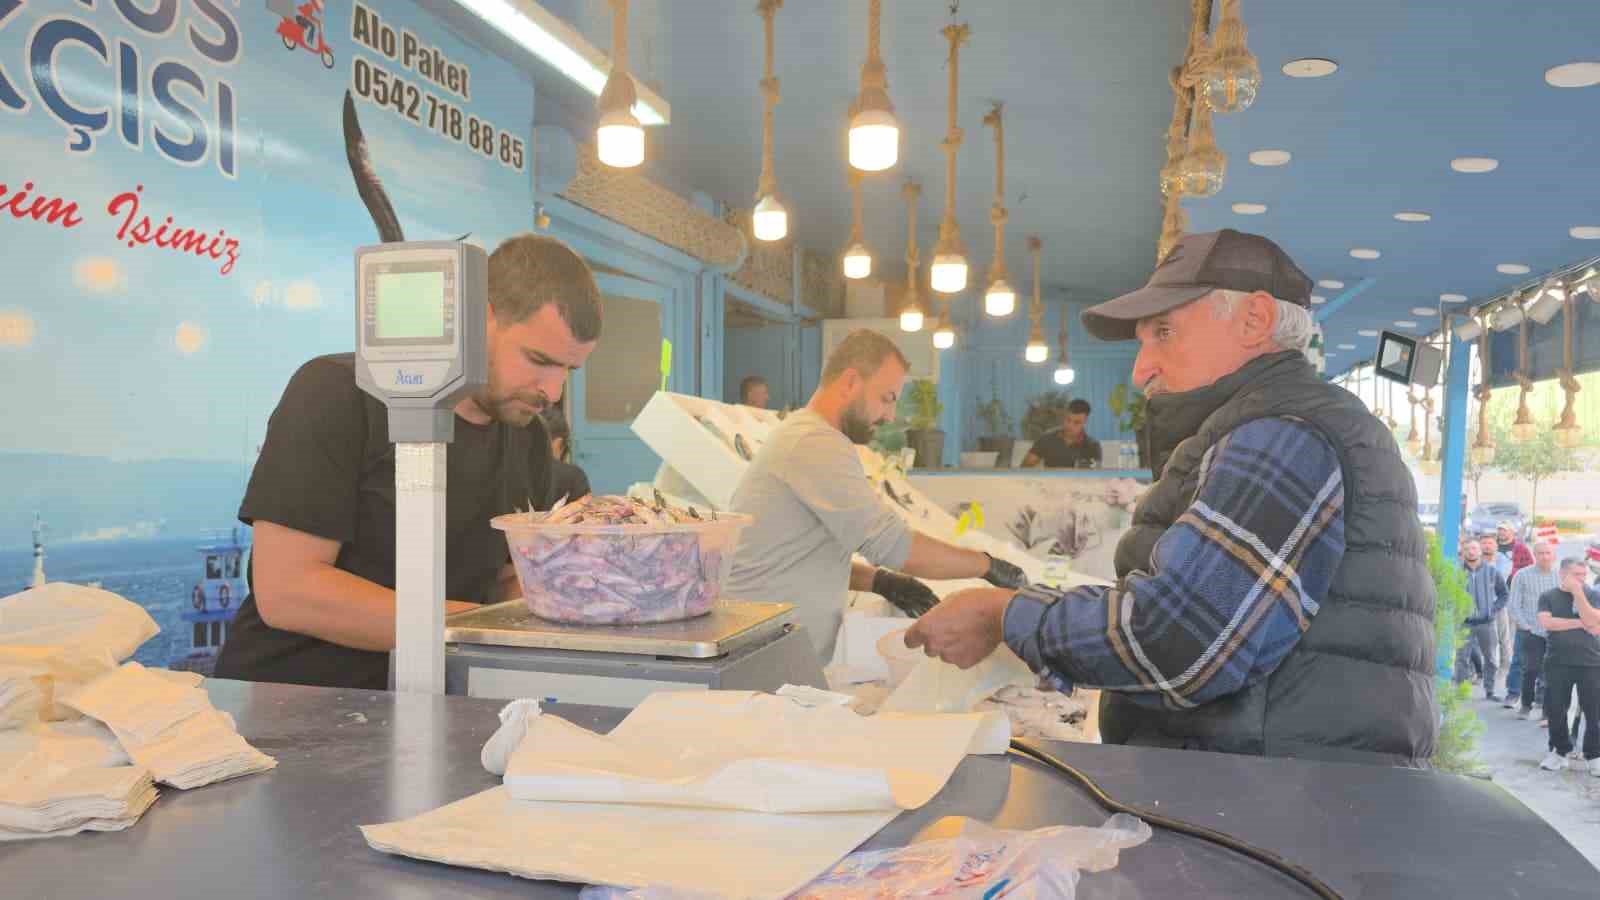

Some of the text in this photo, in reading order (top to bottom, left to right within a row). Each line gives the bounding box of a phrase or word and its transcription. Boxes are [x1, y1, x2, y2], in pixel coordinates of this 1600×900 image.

[352, 5, 470, 97] Alo Paket
[353, 58, 524, 169] 0542 718 88 85
[107, 184, 240, 275] İşimiz
